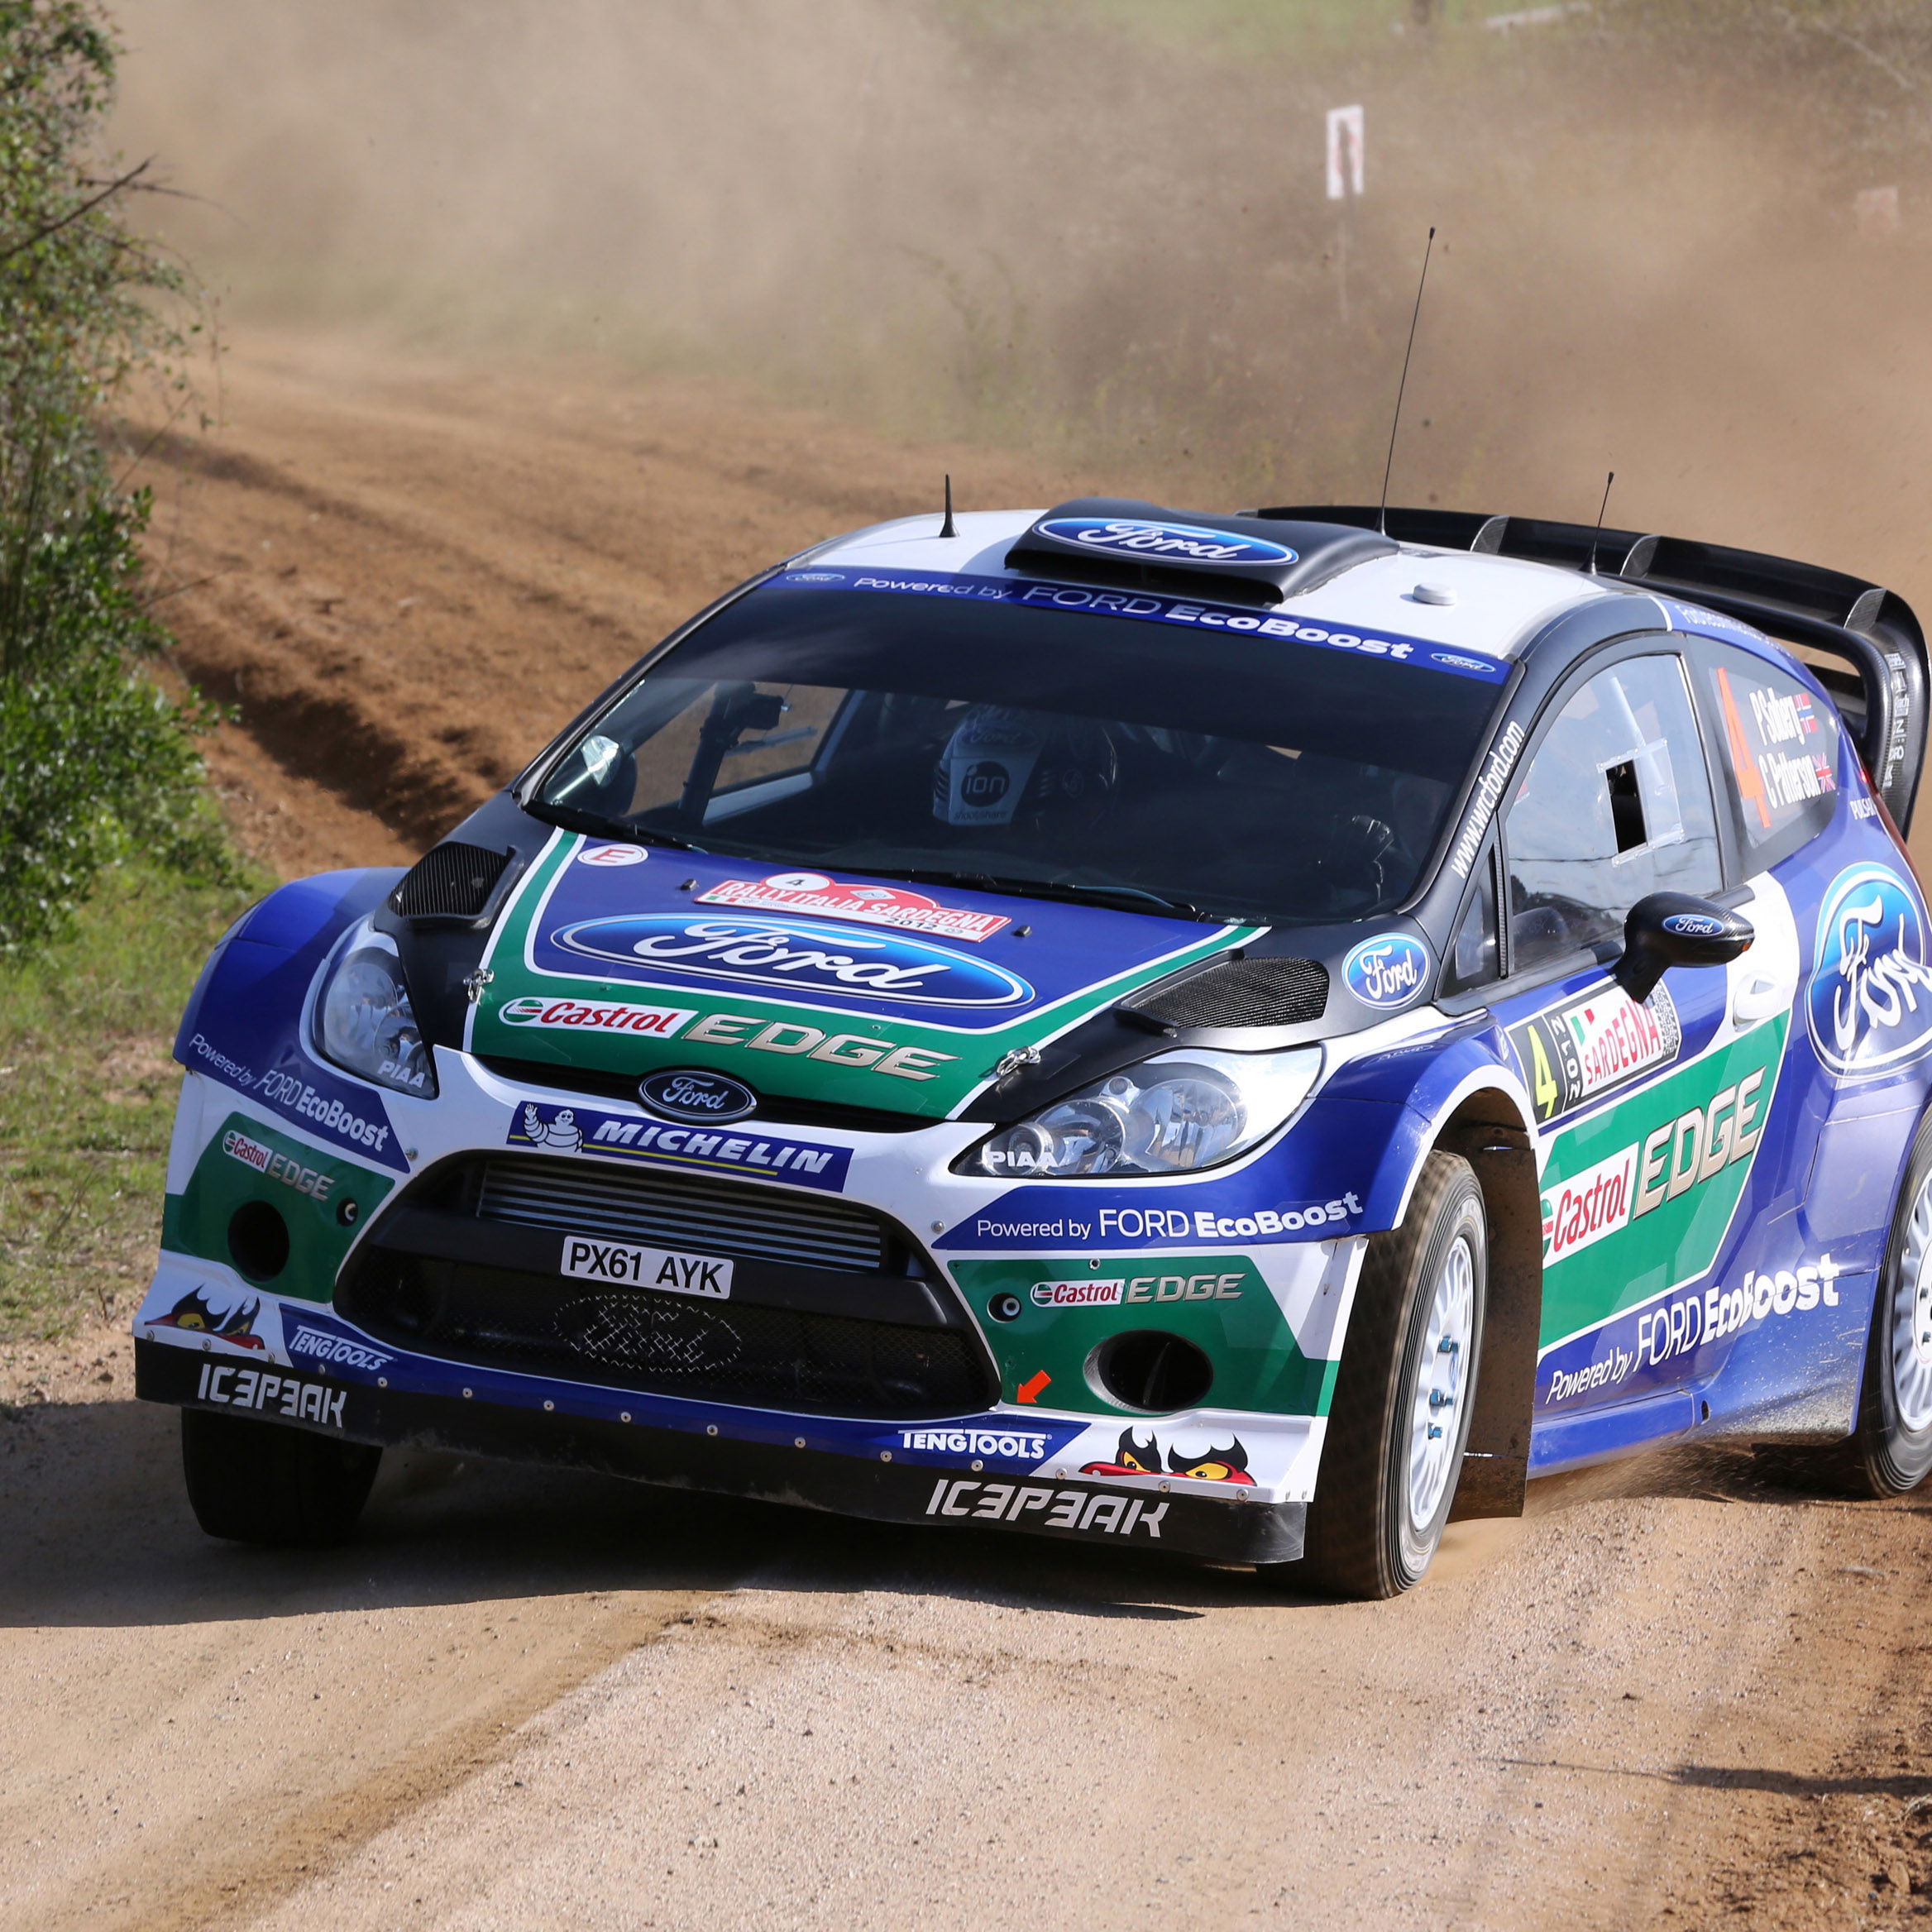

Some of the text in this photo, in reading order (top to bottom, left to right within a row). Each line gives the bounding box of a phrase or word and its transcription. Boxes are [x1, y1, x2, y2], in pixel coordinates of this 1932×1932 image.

[1078, 520, 1254, 561] Ford
[854, 577, 1414, 659] Powered by FORD EcoBoost
[1717, 667, 1771, 830] 4
[965, 764, 1006, 796] ion
[1451, 720, 1525, 879] www.wrcford.com
[600, 848, 637, 864] E
[784, 877, 805, 887] 4
[719, 882, 789, 903] RALLY
[787, 891, 873, 914] ITALIA
[861, 901, 995, 933] SARDEGNA
[885, 916, 940, 931] 2012
[1673, 914, 1715, 935] Ford
[633, 921, 952, 990] Ford
[1359, 944, 1418, 1000] Ford
[1834, 894, 1932, 1051] Ford
[540, 1001, 964, 1082] Castrol EDGE
[1550, 1015, 1582, 1102] 2012
[1584, 998, 1662, 1085] SARDEGNA
[189, 1033, 390, 1153] Powered by FORD EcoBoost
[377, 1059, 426, 1089] PIAA
[662, 1078, 727, 1110] Ford
[1527, 1024, 1558, 1120] 4
[233, 1136, 337, 1202] Castrol EDGE
[592, 1119, 834, 1174] MICHELIN
[987, 1150, 1062, 1169] PIAA
[1552, 1065, 1768, 1253] Castrol EDGE
[977, 1191, 1364, 1240] Powered by FORD EcoBoost
[569, 1241, 724, 1294] PX61 AYK
[1052, 1272, 1248, 1305] Castrol EDGE
[1545, 1252, 1841, 1404] Powered by FORD EcoBoost
